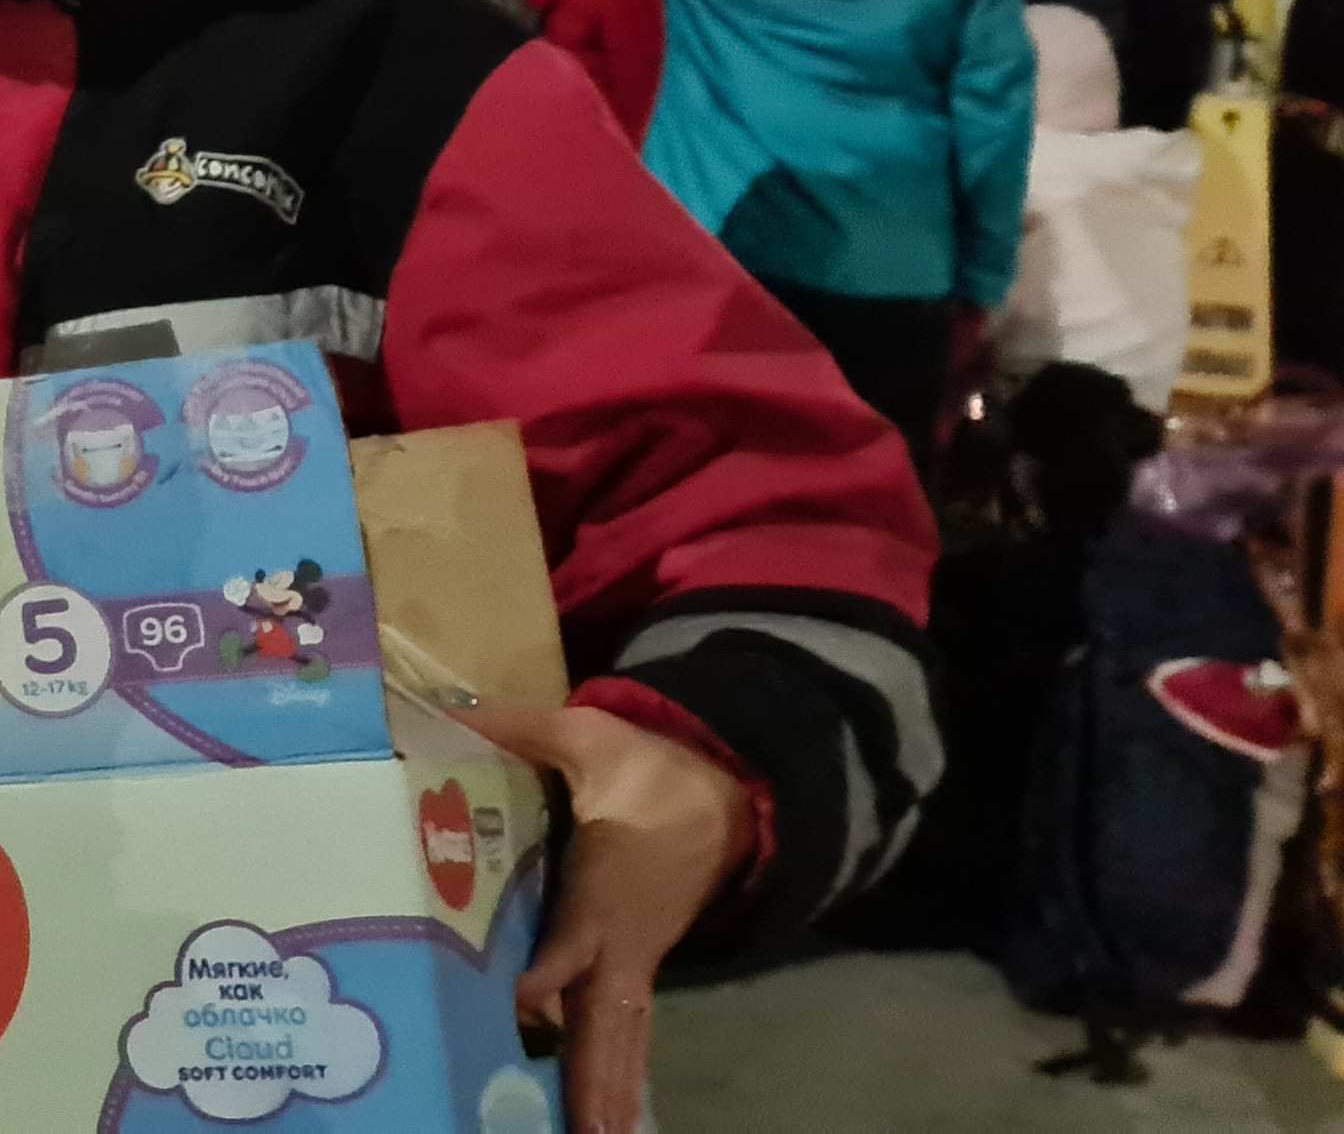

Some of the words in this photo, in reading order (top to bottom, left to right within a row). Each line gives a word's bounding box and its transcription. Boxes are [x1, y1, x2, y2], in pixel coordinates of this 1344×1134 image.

[197, 158, 296, 212] concor
[21, 597, 78, 675] 5
[139, 615, 188, 646] 96
[188, 957, 289, 981] Мягкие,
[218, 983, 264, 1001] как
[183, 1002, 308, 1028] облачко
[204, 1034, 294, 1061] Cloud
[178, 1066, 227, 1082] SOFT
[231, 1064, 328, 1081] COMFORT
